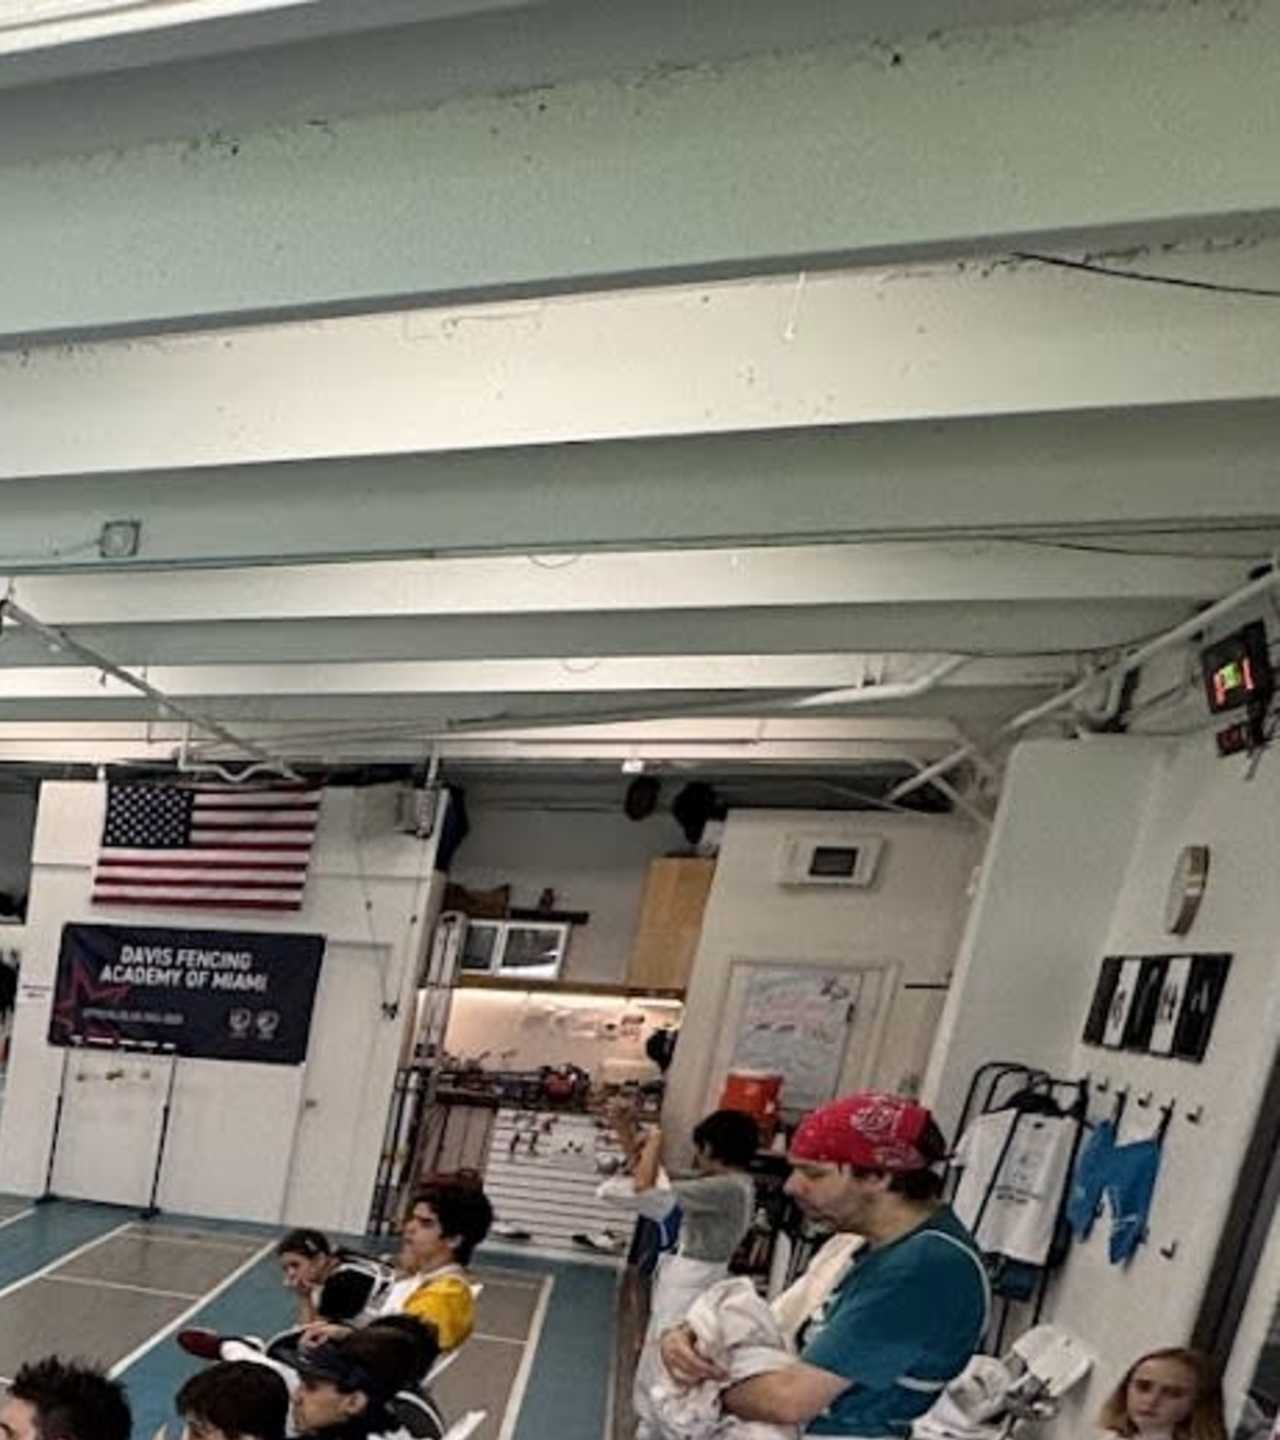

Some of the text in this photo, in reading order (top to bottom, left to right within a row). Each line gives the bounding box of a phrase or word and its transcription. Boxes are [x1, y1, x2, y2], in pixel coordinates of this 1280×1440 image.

[120, 945, 253, 971] DAVIS FENCING
[99, 964, 269, 992] ACADEMY OF MIAMI
